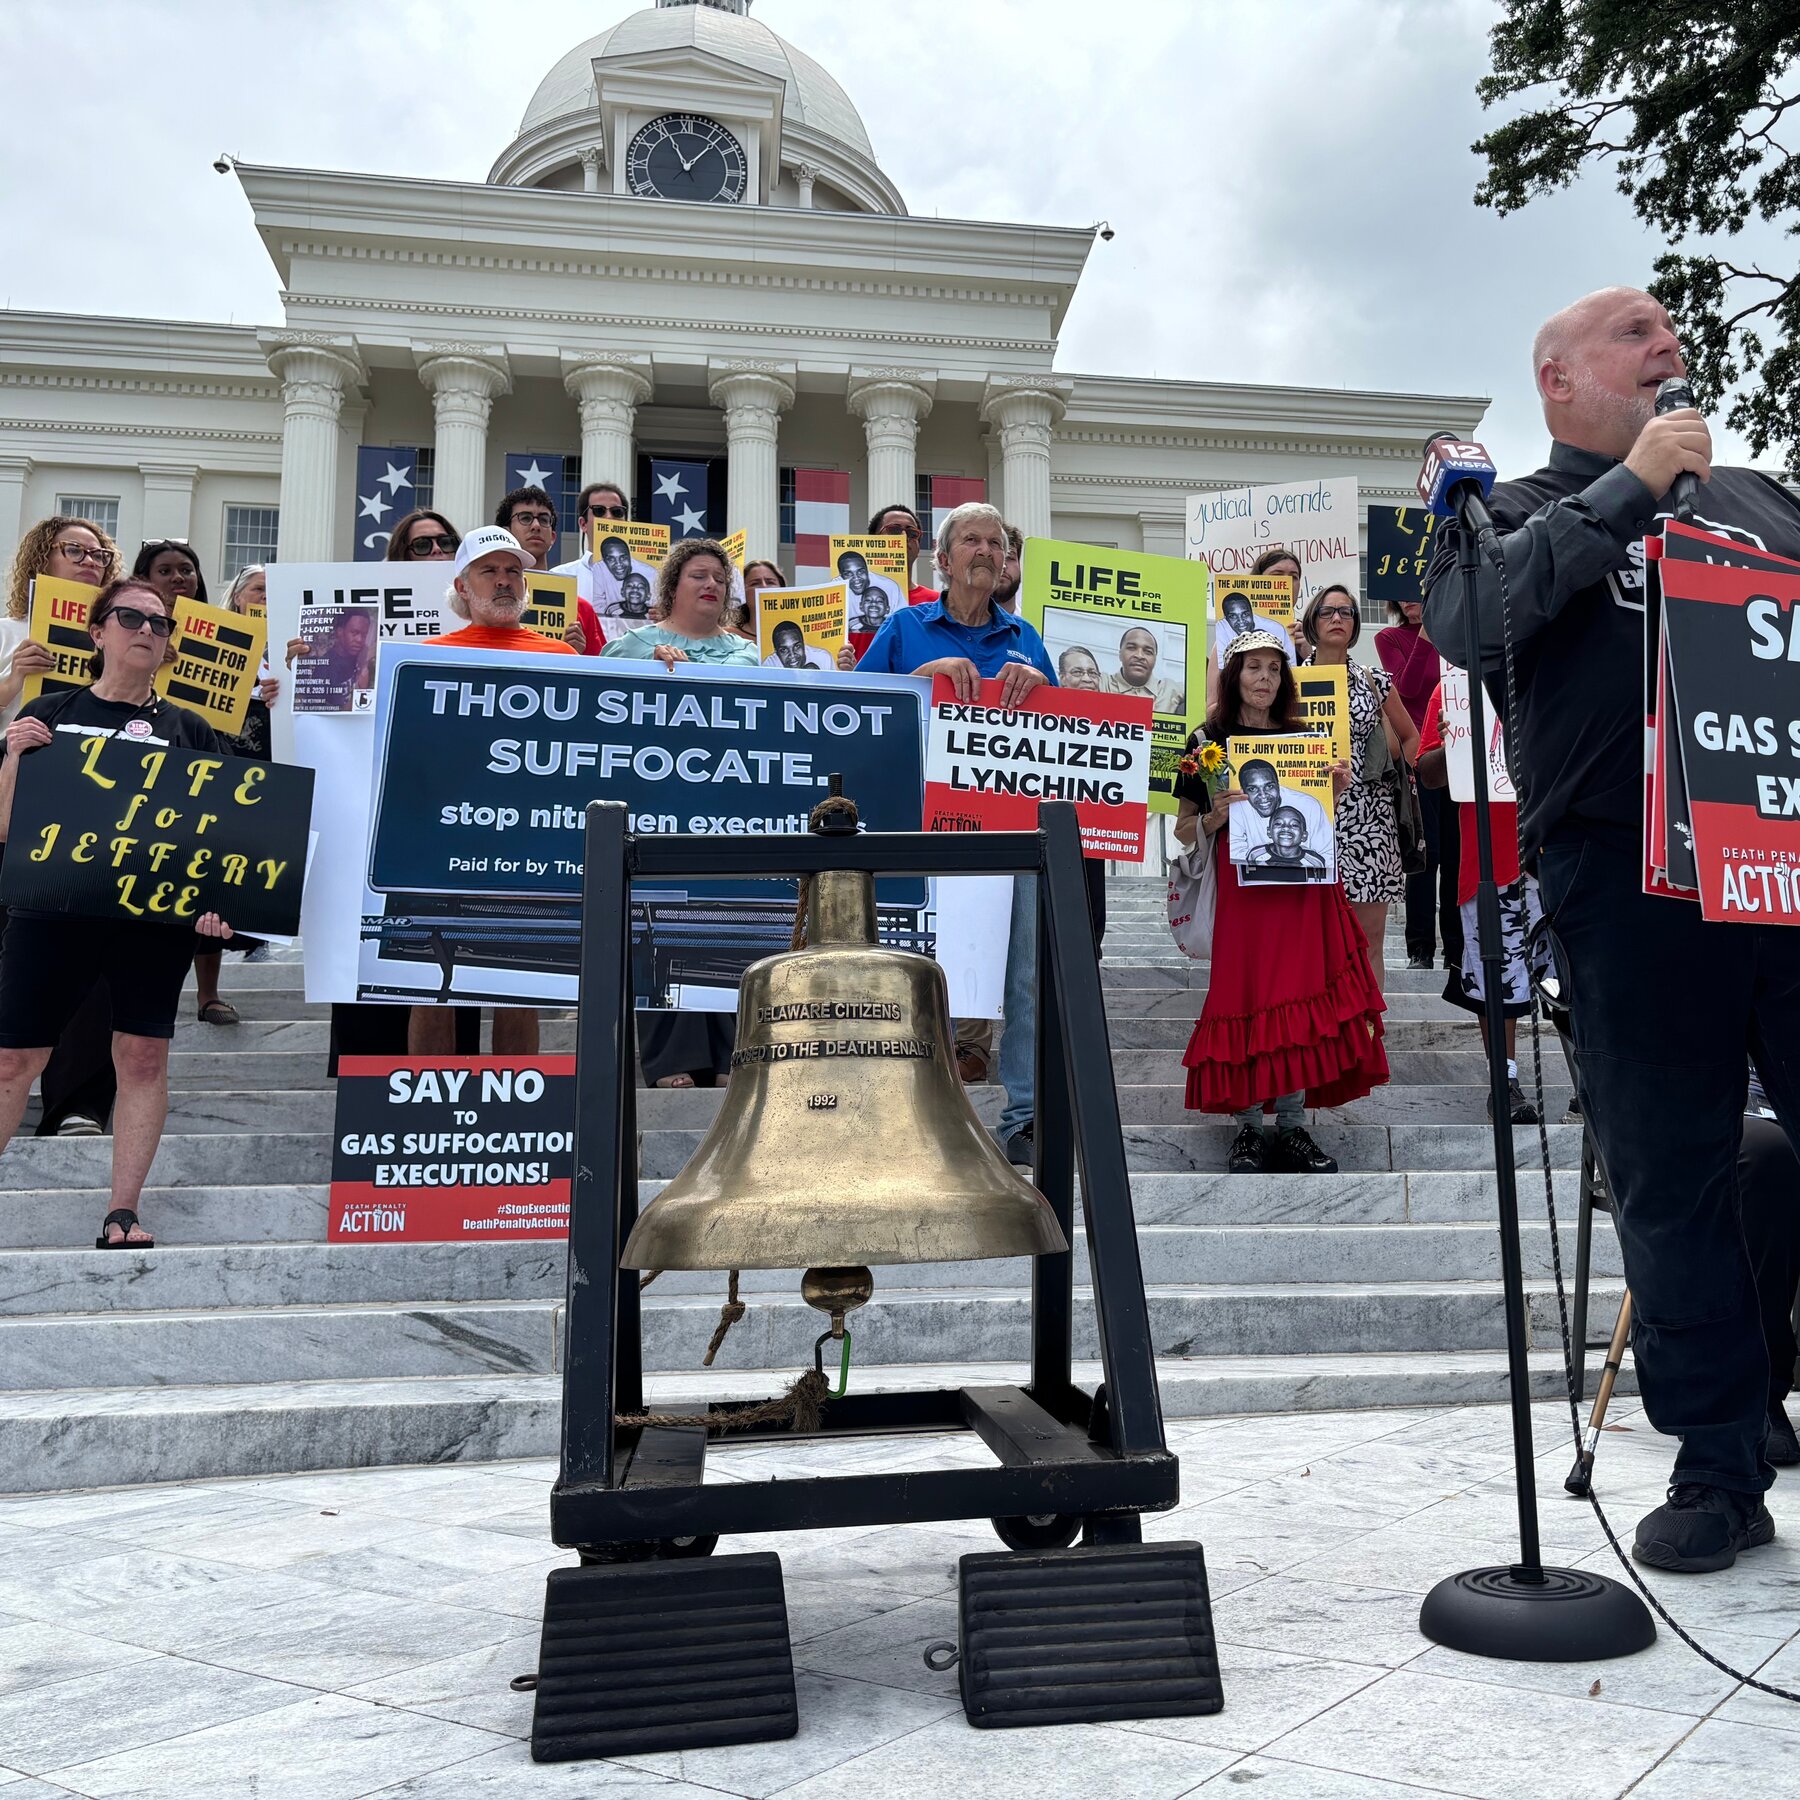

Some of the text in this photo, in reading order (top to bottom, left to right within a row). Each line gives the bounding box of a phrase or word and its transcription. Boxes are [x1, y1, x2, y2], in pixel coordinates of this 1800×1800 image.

[1441, 444, 1486, 461] 12
[1420, 451, 1440, 494] 12
[1447, 460, 1493, 470] WSFA
[1427, 467, 1445, 506] WSFA
[1190, 481, 1333, 545] judicial override
[597, 523, 667, 538] THE JURY VOTED LIFE.
[833, 539, 845, 547] THE
[865, 540, 886, 548] VOTED
[888, 540, 903, 548] LIFE.
[1050, 561, 1161, 600] LIFE FOR
[1218, 580, 1289, 590] THE JURY VOTED LIFE.
[51, 598, 87, 625] LIFE
[301, 608, 324, 616] DON'T
[763, 592, 842, 610] THE JURY VOTED LIFE.
[1050, 589, 1162, 614] JEFFERY LEE
[300, 617, 334, 625] JEFFERY
[416, 610, 439, 618] FOR
[541, 610, 565, 628] FOR
[184, 616, 216, 639] LIFE
[404, 623, 441, 636] LEE
[218, 648, 248, 672] FOR
[173, 659, 240, 692] JEFFERY
[209, 692, 236, 714] LEE
[423, 680, 893, 737] THOU SHALT NOT
[1310, 701, 1336, 716] FOR
[938, 703, 1144, 742] EXECUTIONS ARE
[1162, 723, 1182, 731] LIFE
[1693, 711, 1778, 756] GAS
[946, 730, 1133, 771] LEGALIZED
[1234, 743, 1250, 754] THE
[1252, 743, 1274, 754] JURY
[1278, 744, 1304, 754] VOTED
[1307, 744, 1328, 755] LIFE.
[80, 737, 266, 805] LIFE
[487, 738, 829, 787] SUFFOCATE.
[1276, 760, 1307, 768] ALABAMA
[1288, 770, 1315, 778] EXECUTE
[1301, 779, 1330, 788] ANYWAY.
[950, 766, 1125, 805] LYNCHING
[115, 794, 217, 834] for
[440, 802, 520, 831] stop
[30, 824, 287, 890] JEFFERY
[1081, 840, 1138, 855] ltyAction.org
[1722, 847, 1765, 861] DEATH
[449, 857, 584, 877] Paid for by The
[117, 874, 199, 916] LEE
[757, 1003, 900, 1023] DELAWARE CITIZENS
[770, 1044, 787, 1059] TO
[790, 1042, 819, 1057] THE
[825, 1040, 877, 1055] DEATH
[388, 1070, 545, 1104] SAY NO
[808, 1094, 836, 1107] 1992
[453, 1110, 478, 1125] TO
[340, 1133, 396, 1155] GAS
[375, 1162, 549, 1186] EXECUTIONS!
[339, 1210, 405, 1233] ACTION
